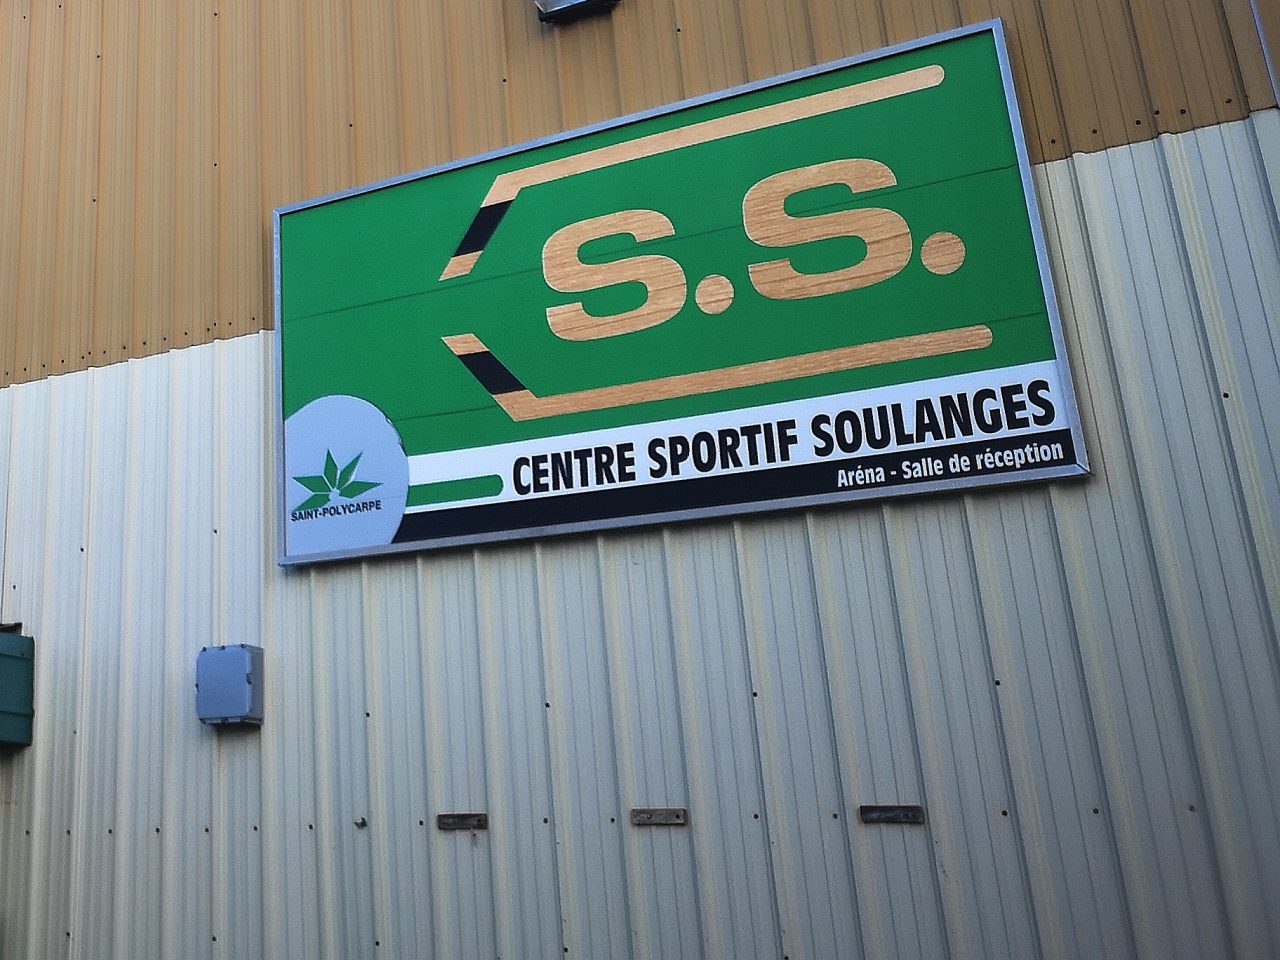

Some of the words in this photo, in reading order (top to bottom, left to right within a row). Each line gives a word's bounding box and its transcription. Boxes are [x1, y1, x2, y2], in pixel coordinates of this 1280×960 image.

[513, 440, 635, 496] CENTRE
[646, 418, 799, 477] SPORTIF
[812, 378, 1057, 458] SOULANGES
[836, 465, 885, 489] Aréna
[901, 456, 945, 481] Salle
[947, 451, 973, 474] de
[975, 440, 1065, 472] réception
[290, 499, 383, 523] SAINT-POLYCARPE
